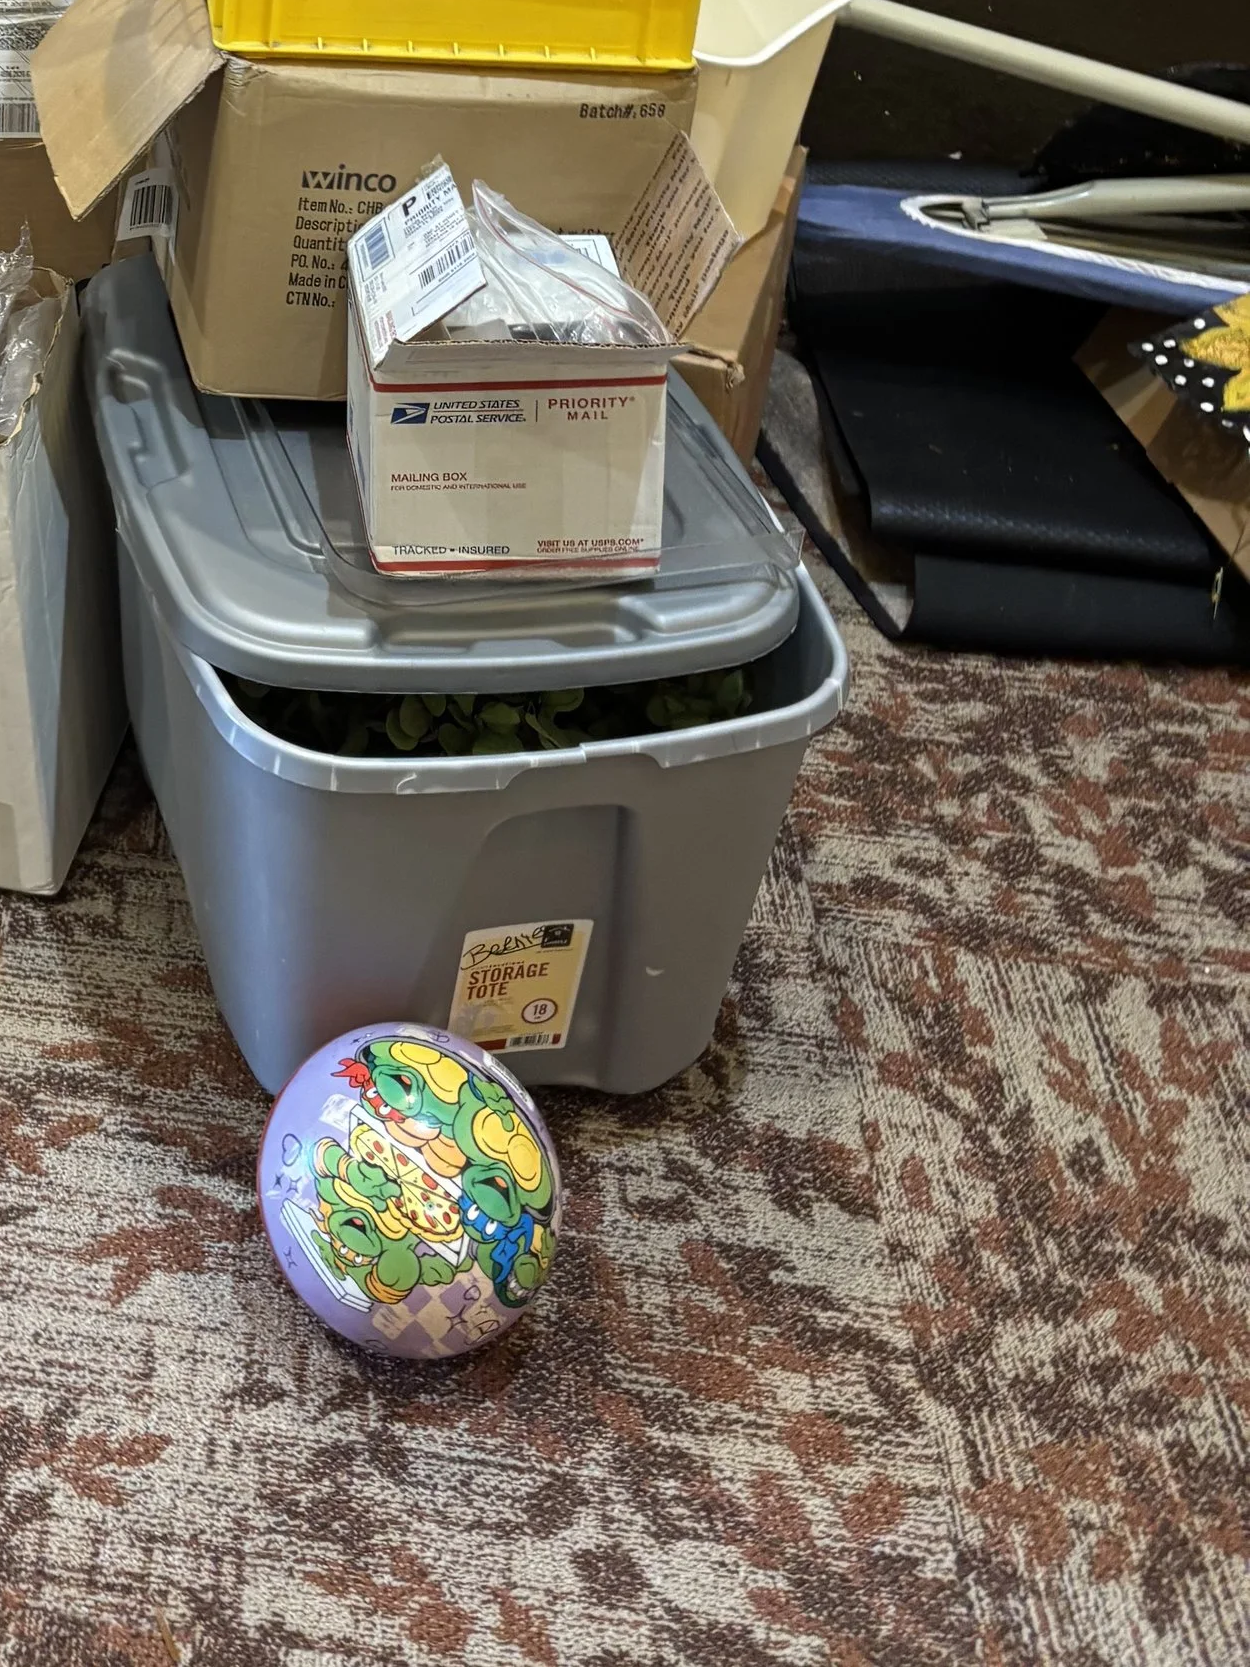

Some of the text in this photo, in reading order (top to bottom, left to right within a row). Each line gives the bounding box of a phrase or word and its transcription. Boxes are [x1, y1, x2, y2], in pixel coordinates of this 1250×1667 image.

[299, 197, 328, 212] Item
[402, 196, 417, 218] P
[293, 235, 348, 252] Quantit
[288, 272, 321, 288] Made
[324, 274, 336, 288] in
[286, 291, 310, 307] CTN
[433, 400, 477, 410] UNITED
[480, 399, 520, 409] STATES
[431, 414, 474, 424] POSTAL
[567, 410, 609, 421] MAIL
[391, 472, 467, 483] MAILING BOX
[393, 545, 510, 555] TRACKED INSURED
[537, 539, 561, 547] VISIT
[563, 539, 575, 547] US
[577, 539, 589, 547] AT
[468, 962, 550, 986] STORAGE
[467, 981, 509, 1001] TOTE
[533, 1003, 548, 1016] 18
